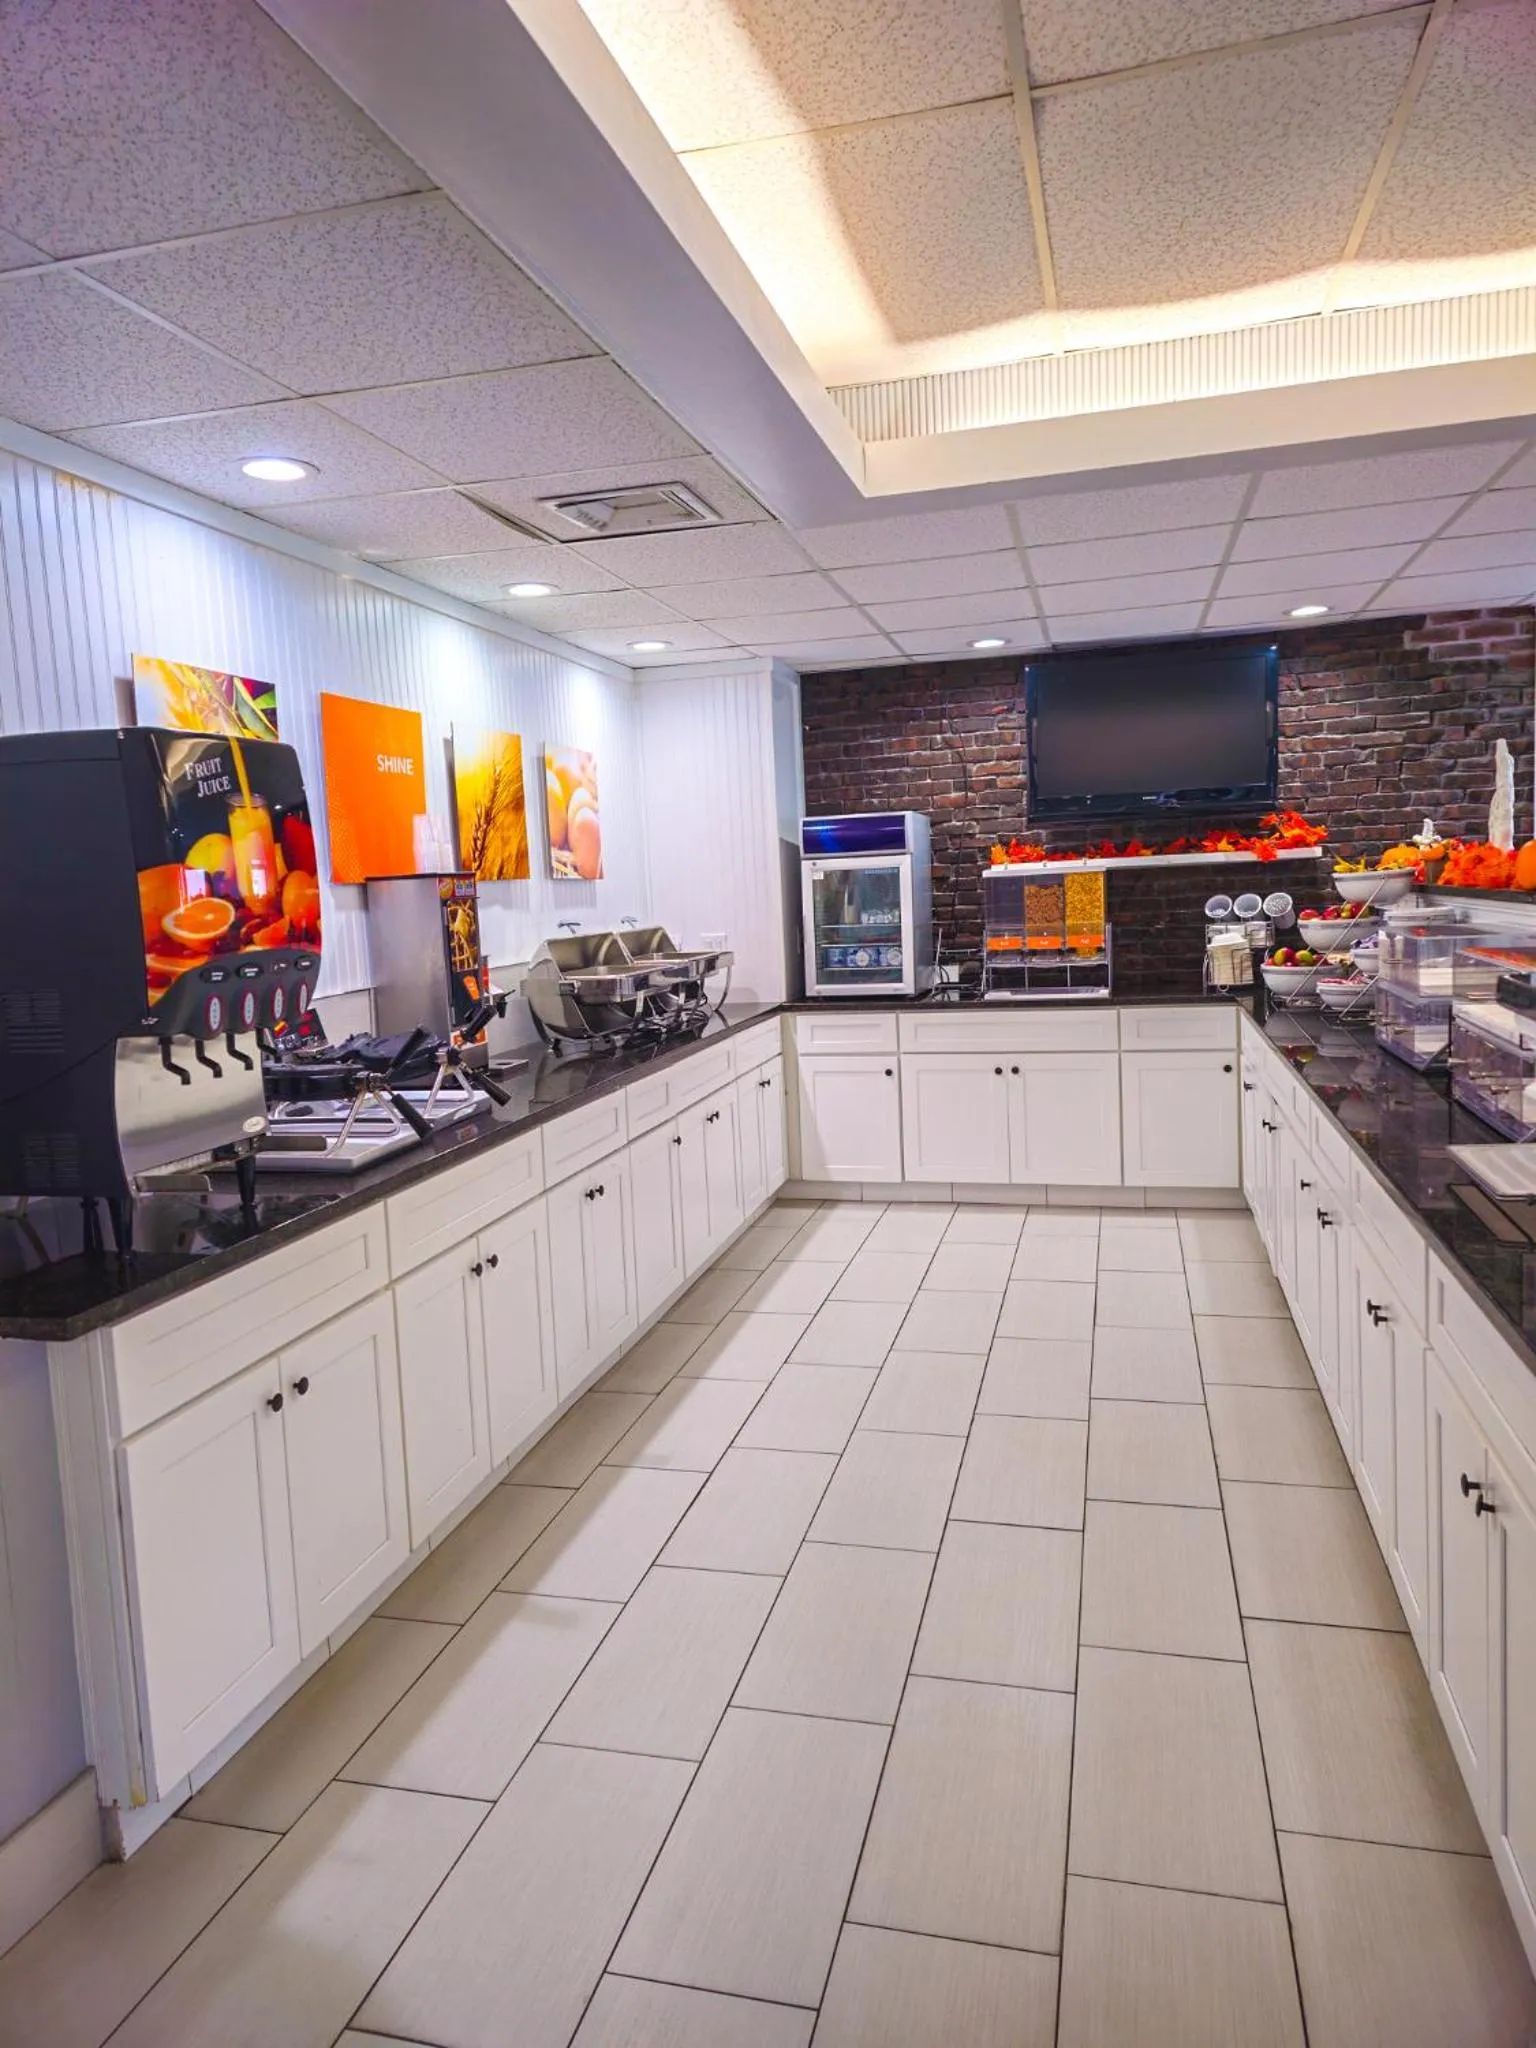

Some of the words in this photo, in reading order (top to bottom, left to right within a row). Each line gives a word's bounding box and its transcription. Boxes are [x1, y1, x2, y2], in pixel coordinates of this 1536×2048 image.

[184, 757, 221, 780] FRUIT
[376, 753, 414, 776] SHINE
[197, 776, 231, 797] JUICE
